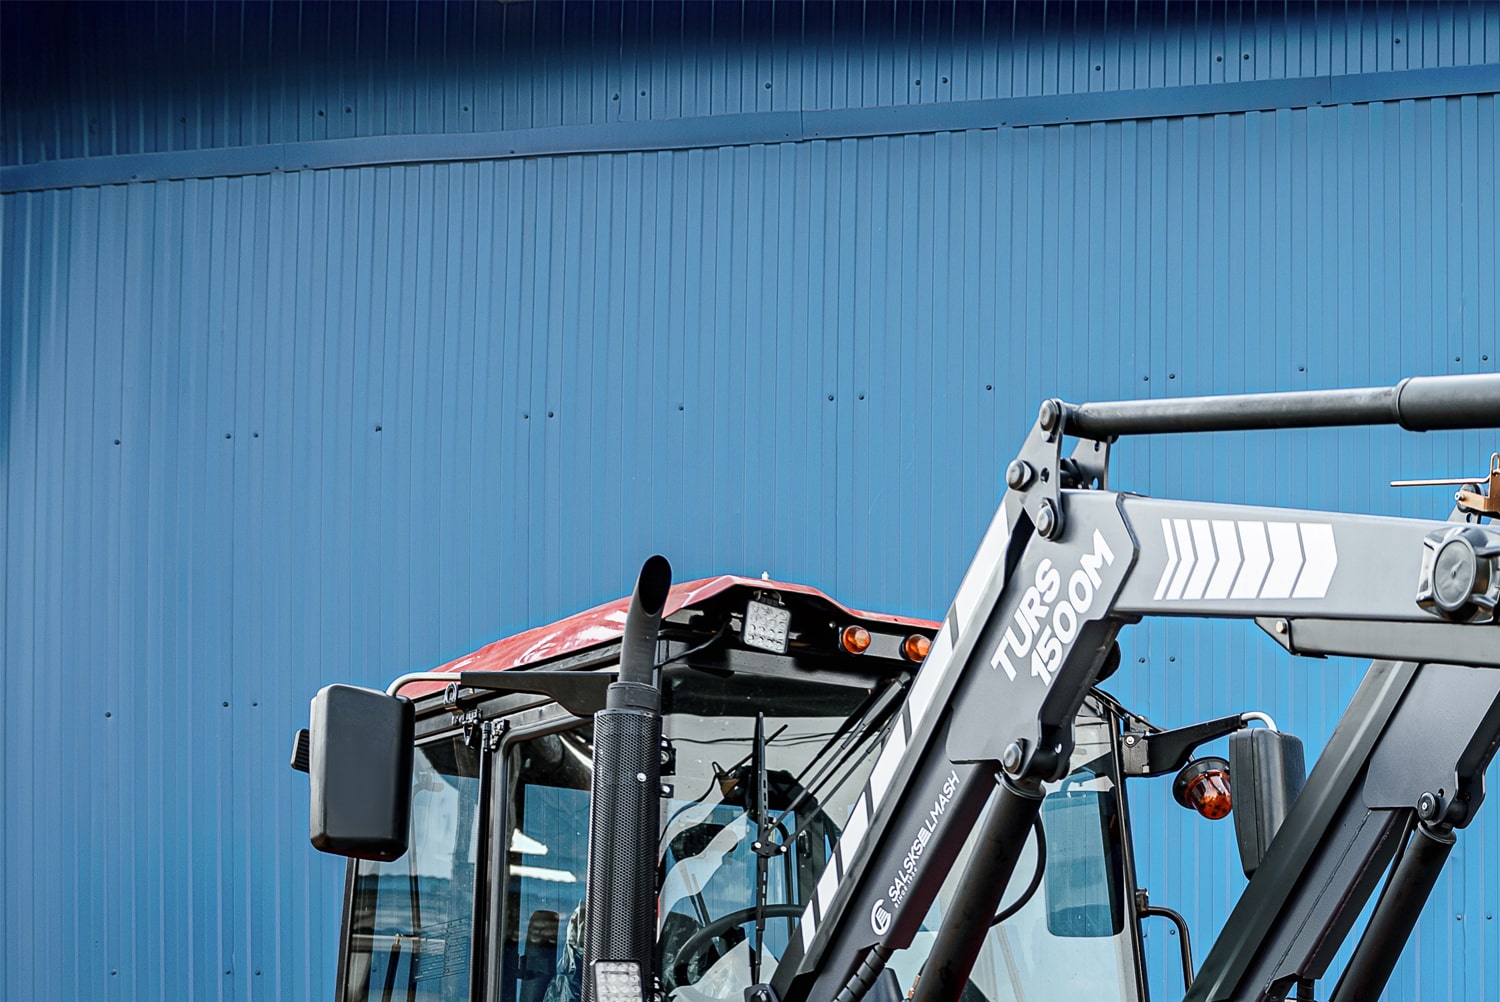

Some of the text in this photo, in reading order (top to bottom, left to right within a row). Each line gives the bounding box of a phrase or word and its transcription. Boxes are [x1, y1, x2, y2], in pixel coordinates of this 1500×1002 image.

[990, 558, 1061, 682] TURS
[1030, 528, 1115, 687] 1500M
[888, 769, 960, 902] SALSKSELMASH
